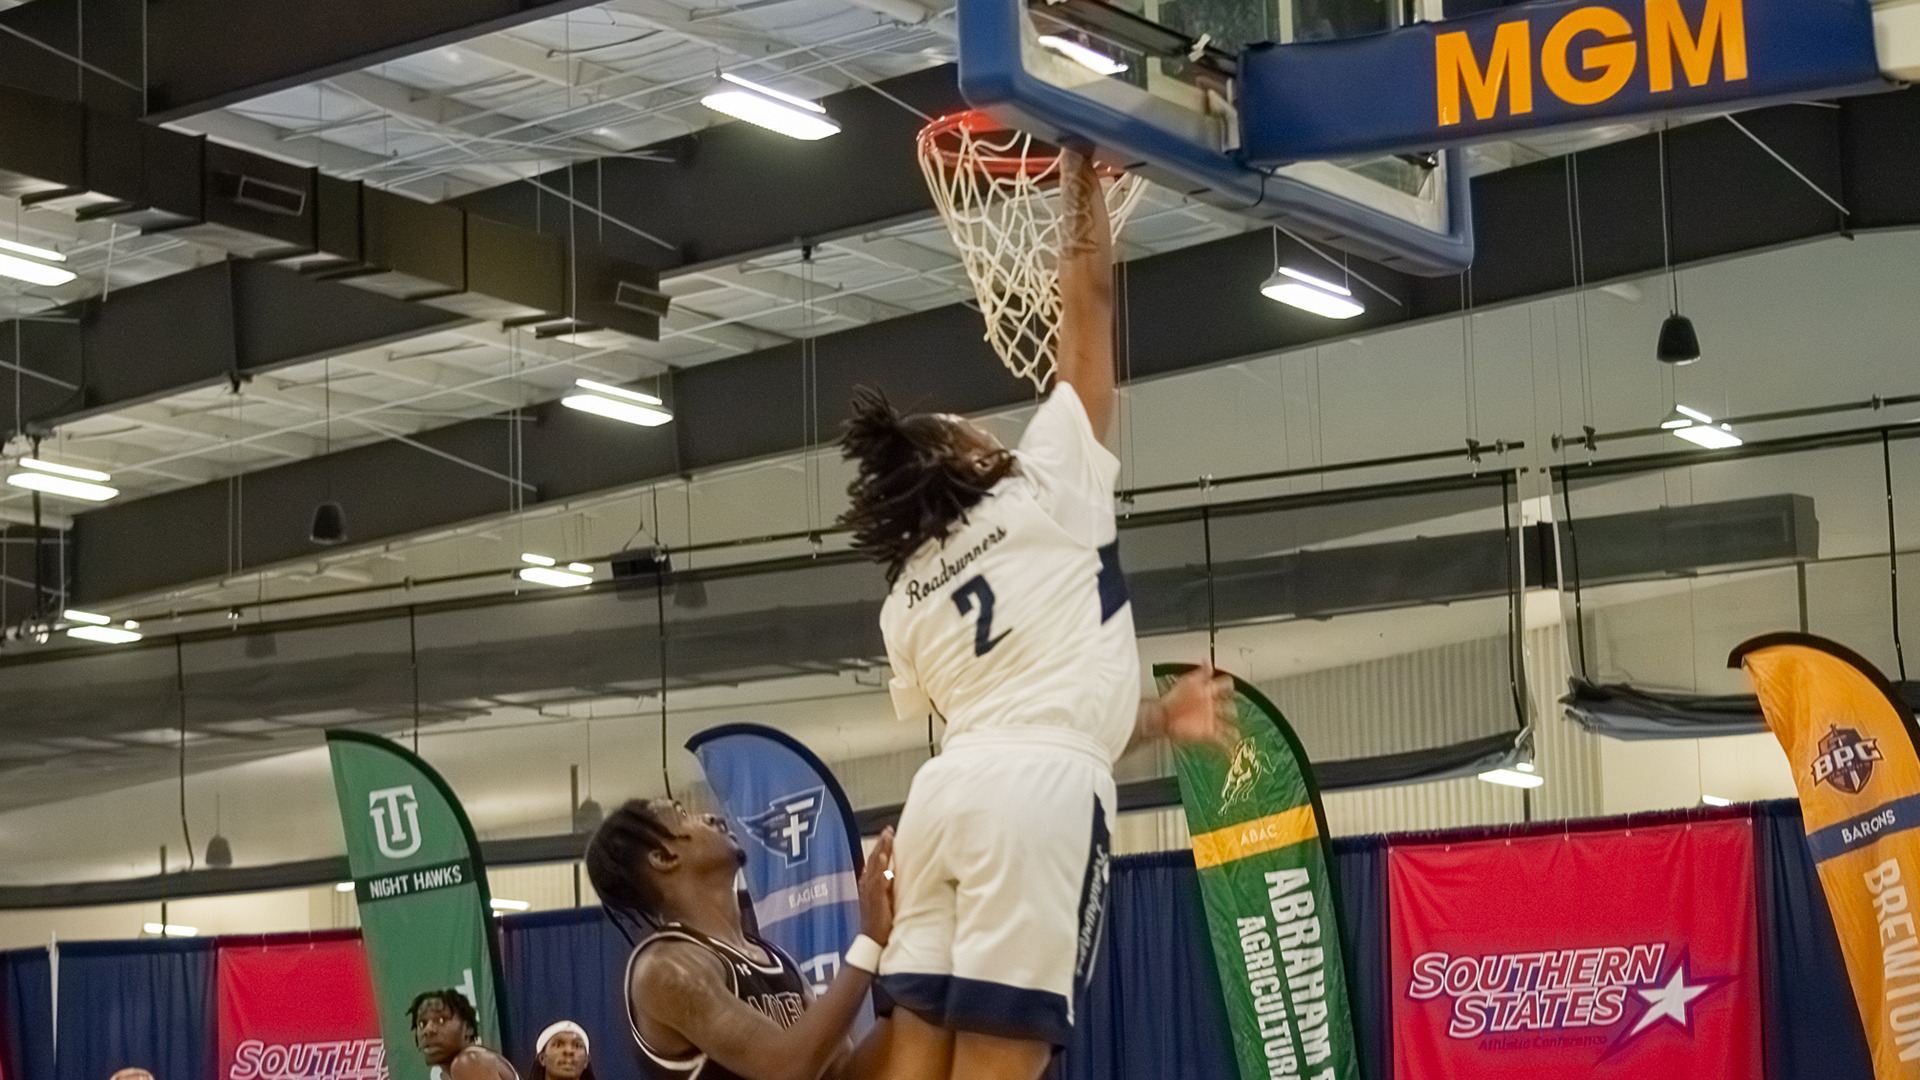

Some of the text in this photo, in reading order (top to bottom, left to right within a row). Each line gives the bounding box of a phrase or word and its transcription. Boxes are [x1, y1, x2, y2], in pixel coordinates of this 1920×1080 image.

[1436, 0, 1748, 126] MGM
[905, 526, 1008, 609] Roadrunners
[951, 574, 1014, 658] 2
[1813, 738, 1883, 784] BPC
[1240, 824, 1278, 847] ABAC
[1841, 809, 1896, 844] BARONS
[369, 864, 462, 899] NIGHT HAWKS
[788, 882, 828, 908] EAGLES
[1264, 867, 1332, 1066] ABRAHAM
[1409, 942, 1665, 999] SOUTHERN
[1449, 986, 1627, 1038] STATES
[230, 1038, 389, 1080] SOUTHE
[1478, 1036, 1531, 1051] Athletic
